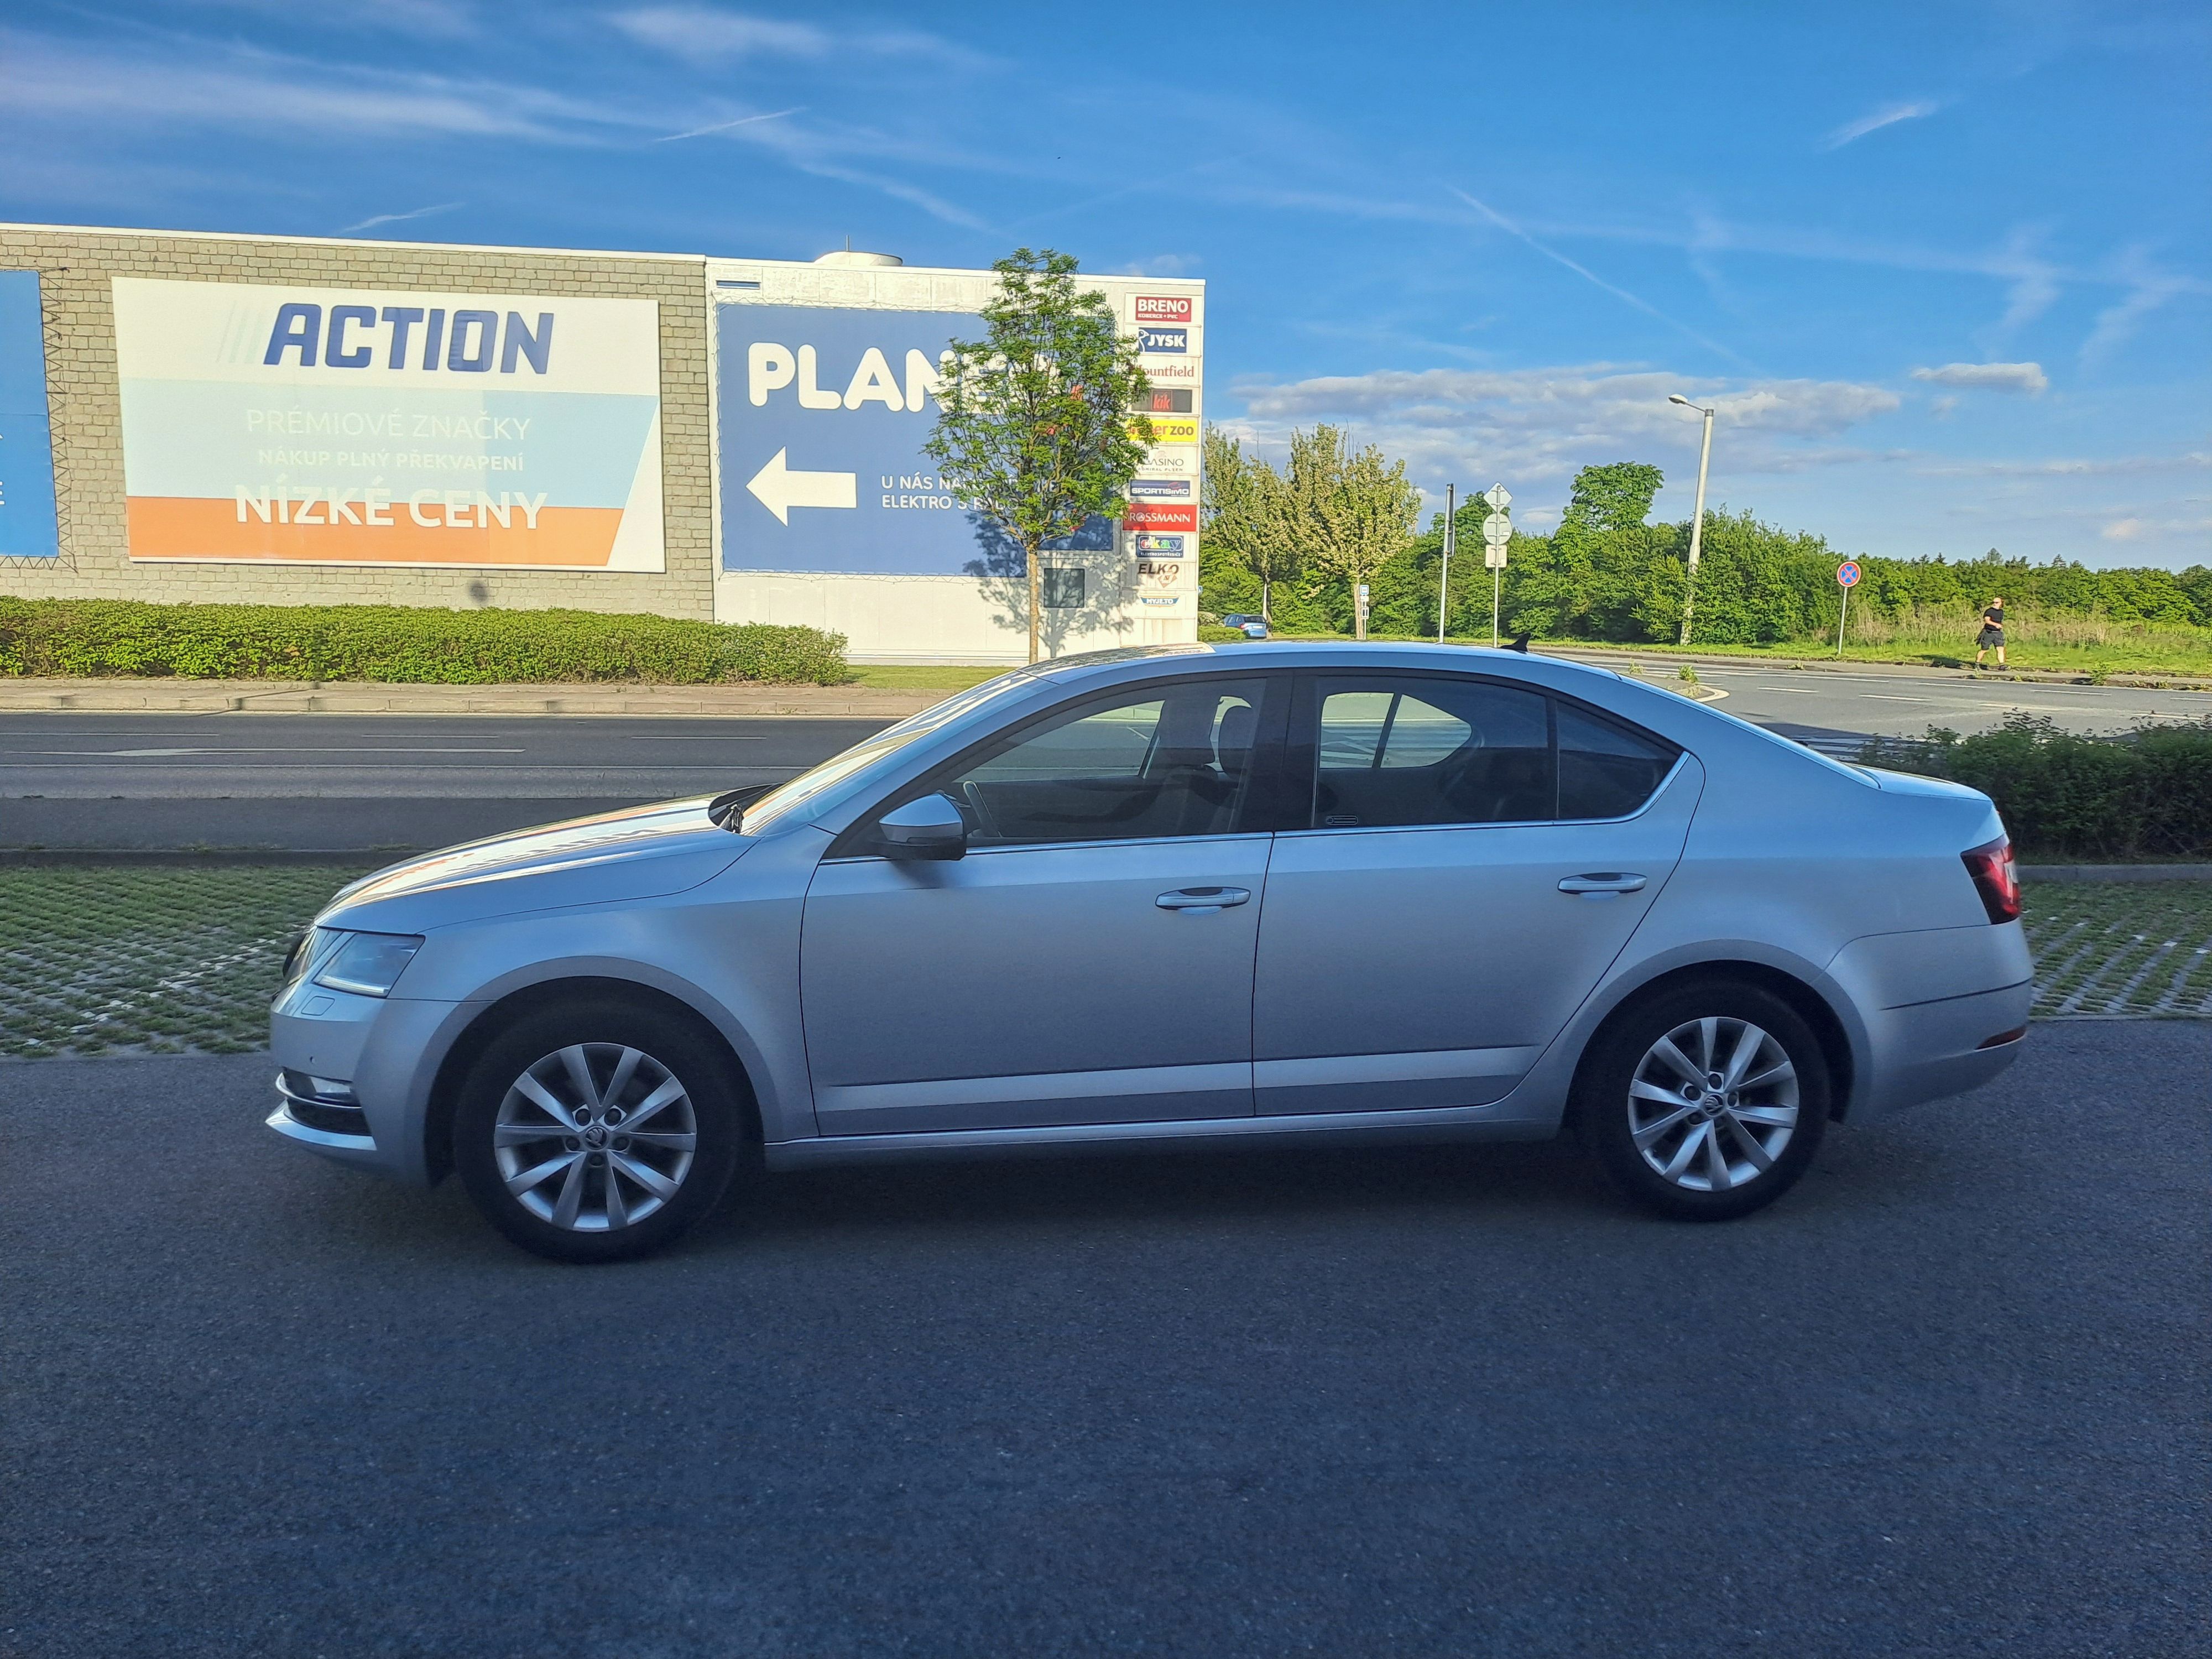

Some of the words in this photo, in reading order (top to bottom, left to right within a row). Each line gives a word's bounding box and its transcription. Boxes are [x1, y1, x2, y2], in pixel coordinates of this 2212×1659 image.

[1138, 299, 1188, 313] BRENO
[263, 303, 554, 374] ACTION
[1147, 334, 1185, 347] JYSK
[1130, 364, 1194, 377] ountfield
[1153, 393, 1171, 409] kik
[247, 405, 404, 437] PRÉMIOVÉ
[413, 410, 531, 440] ZNAČKY
[1170, 425, 1194, 436] zoo
[258, 446, 330, 466] NÁKUP
[337, 447, 389, 468] PLNÝ
[396, 450, 524, 471] PŘEKVAPENÍ
[881, 475, 894, 489] U
[900, 471, 933, 490] NÁS
[234, 473, 395, 526] NÍZKÉ
[409, 489, 549, 530] CENY
[881, 495, 952, 510] ELEKTRO
[1129, 512, 1191, 523] ROSSMANN
[1138, 564, 1180, 575] ELKO
